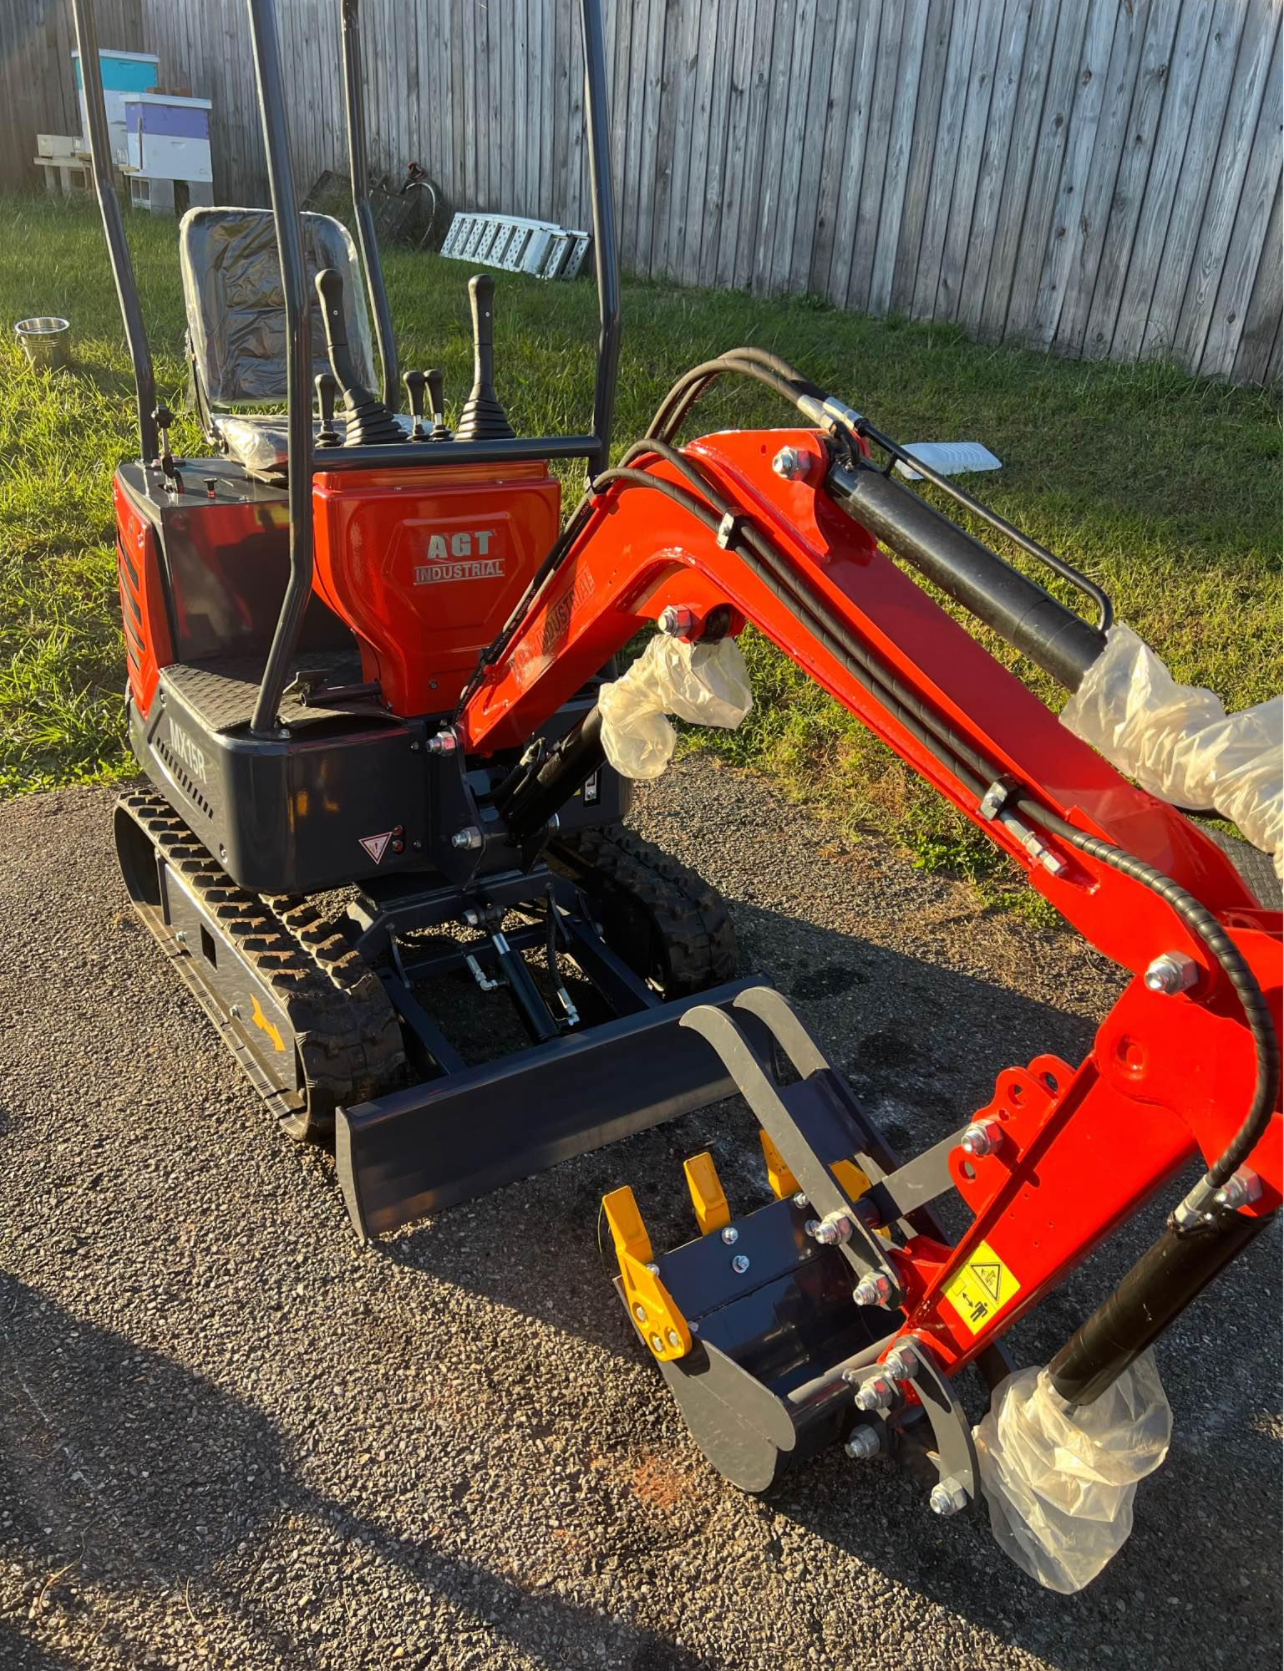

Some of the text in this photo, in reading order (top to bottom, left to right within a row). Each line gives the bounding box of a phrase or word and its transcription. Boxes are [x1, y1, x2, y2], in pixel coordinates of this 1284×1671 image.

[427, 531, 493, 559] AGT
[414, 561, 503, 582] INDUSTRIAL
[168, 716, 207, 785] MX15R
